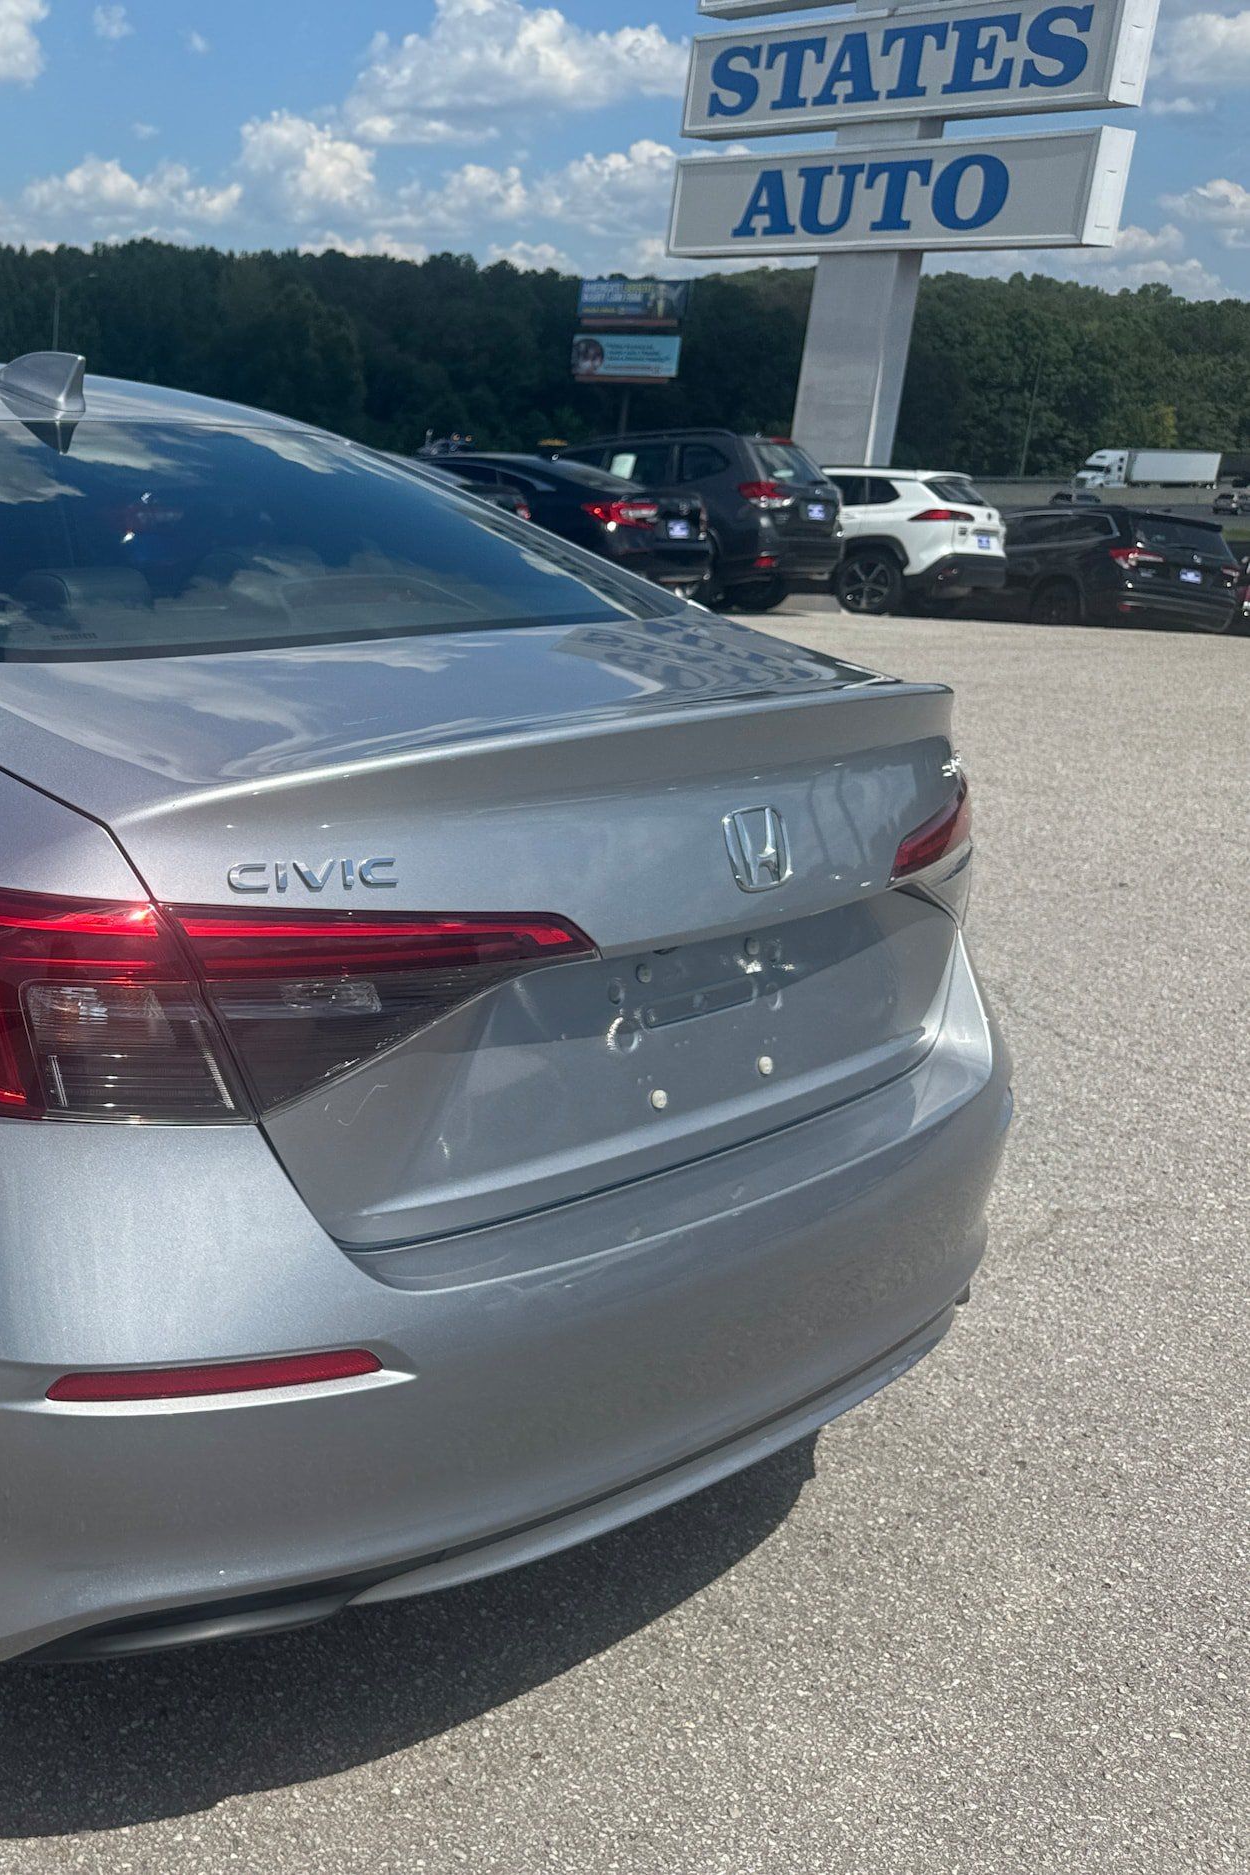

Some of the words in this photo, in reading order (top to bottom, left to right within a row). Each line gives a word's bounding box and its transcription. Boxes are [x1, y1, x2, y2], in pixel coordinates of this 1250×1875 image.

[707, 4, 1094, 118] STATES
[731, 153, 1010, 238] AUTO
[227, 857, 399, 893] CIVIC
